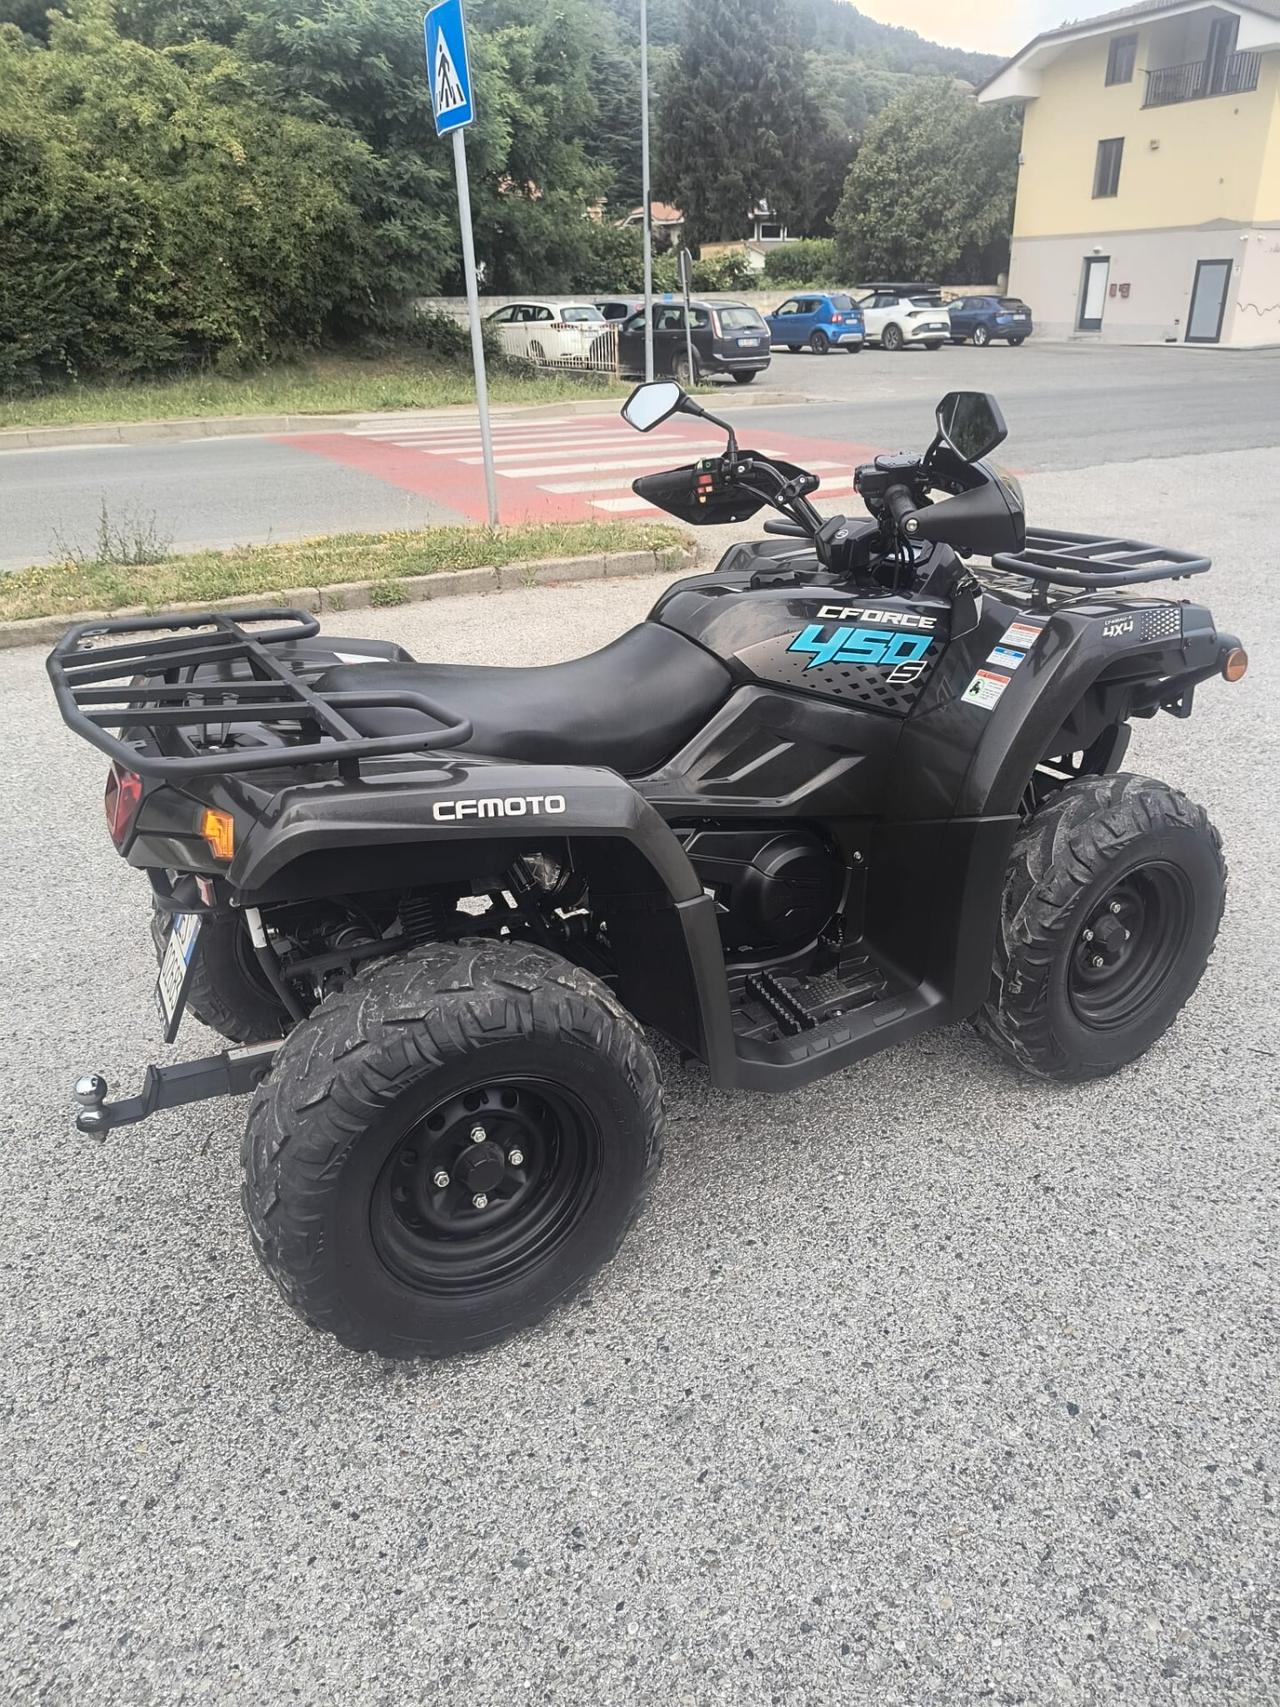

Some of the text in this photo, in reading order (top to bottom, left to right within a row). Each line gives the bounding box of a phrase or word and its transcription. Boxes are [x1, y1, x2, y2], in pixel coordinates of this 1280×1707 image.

[816, 605, 938, 629] CFORCE
[786, 624, 935, 672] 450
[886, 660, 928, 683] S
[433, 795, 566, 821] CFMOTO
